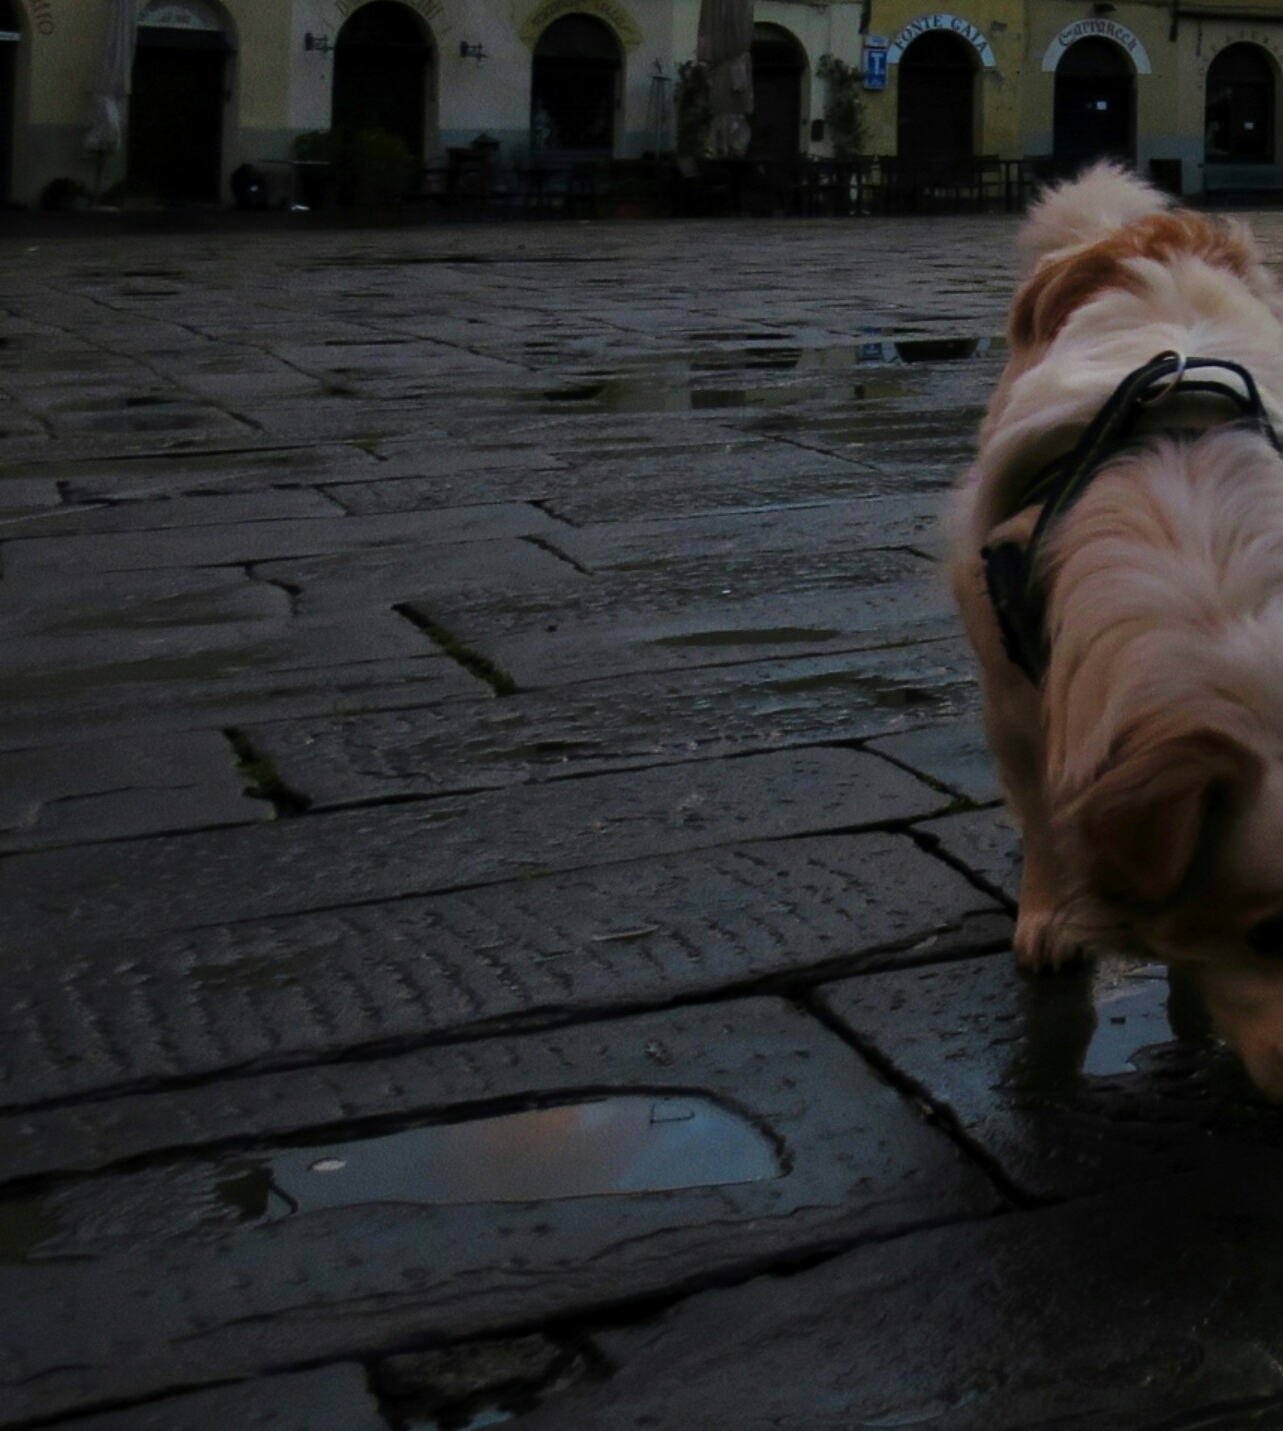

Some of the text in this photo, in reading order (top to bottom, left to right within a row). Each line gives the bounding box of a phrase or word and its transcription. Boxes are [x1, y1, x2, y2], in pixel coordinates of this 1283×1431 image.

[894, 14, 988, 53] FONTE GAIA
[870, 52, 884, 76] T
